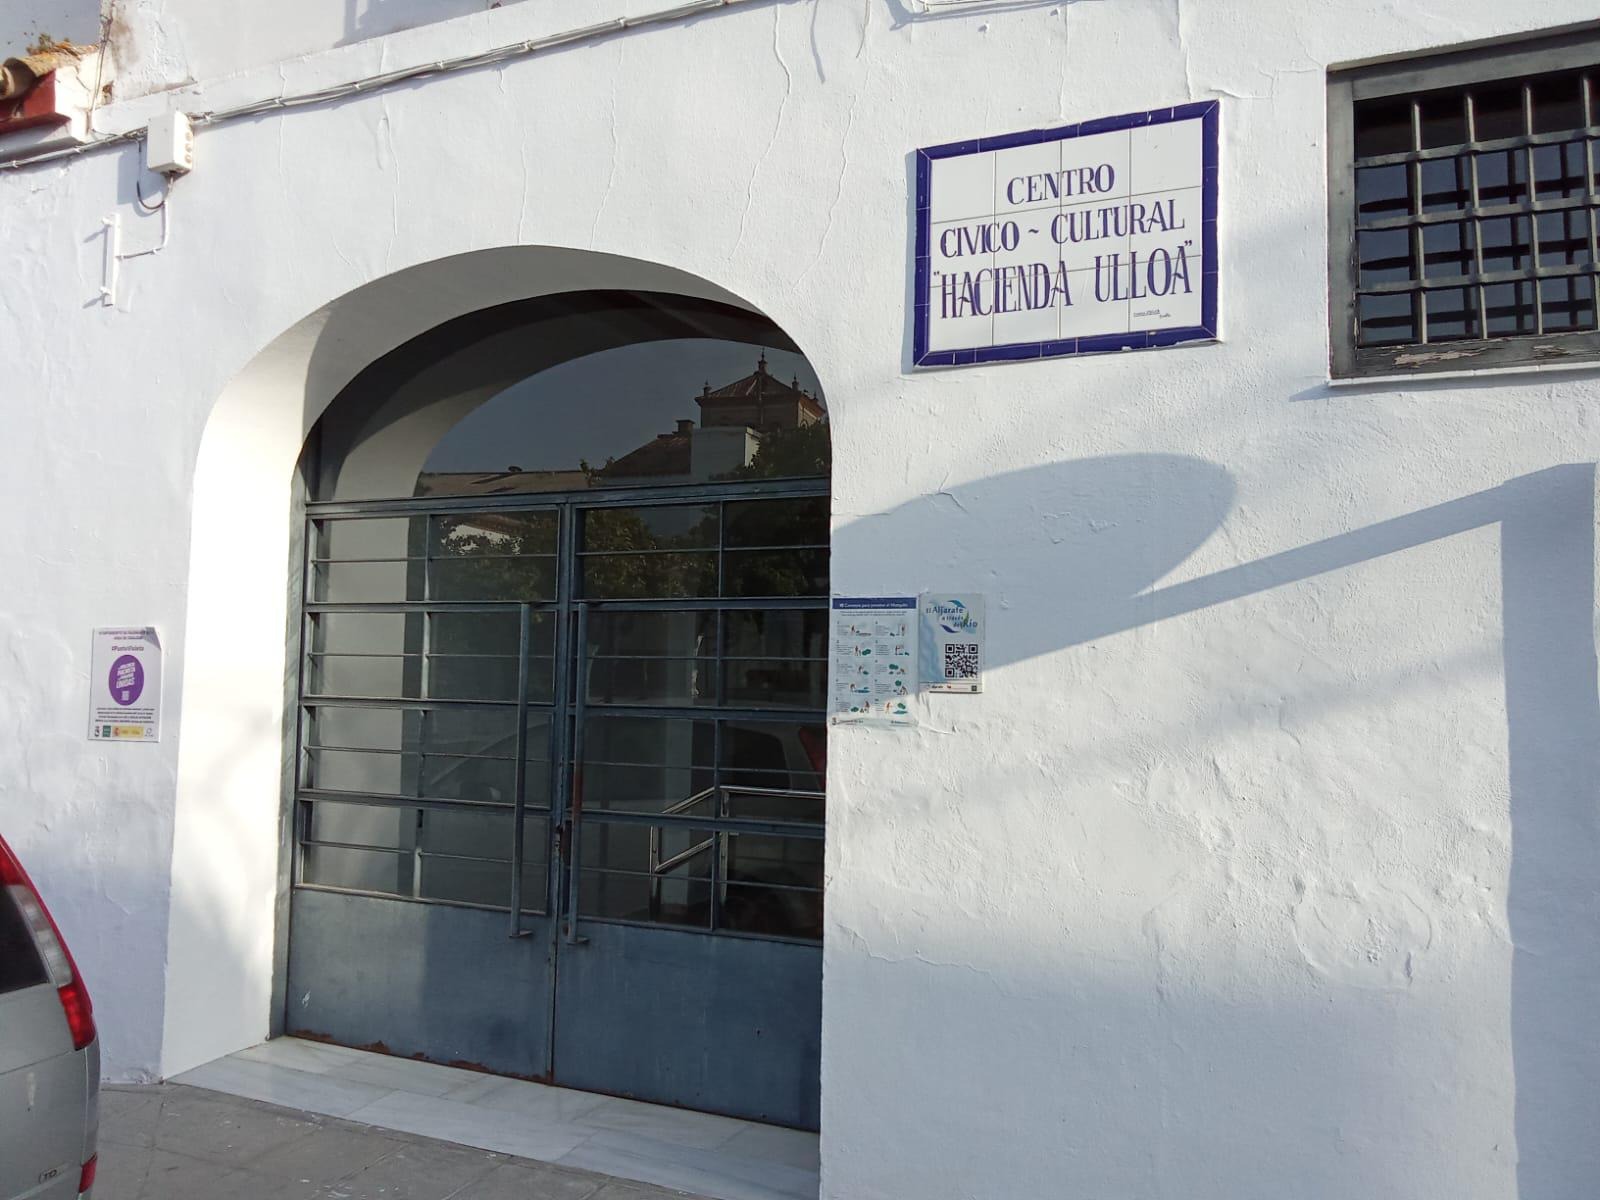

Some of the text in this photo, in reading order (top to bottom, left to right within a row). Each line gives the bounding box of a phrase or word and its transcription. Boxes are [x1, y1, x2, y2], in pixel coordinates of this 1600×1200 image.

[1006, 164, 1115, 205] CENTRO
[940, 221, 1020, 258] CIVICO
[1051, 199, 1185, 244] CULTURAL
[933, 260, 1074, 319] "HACIENDA
[933, 605, 964, 616] Aljarafe
